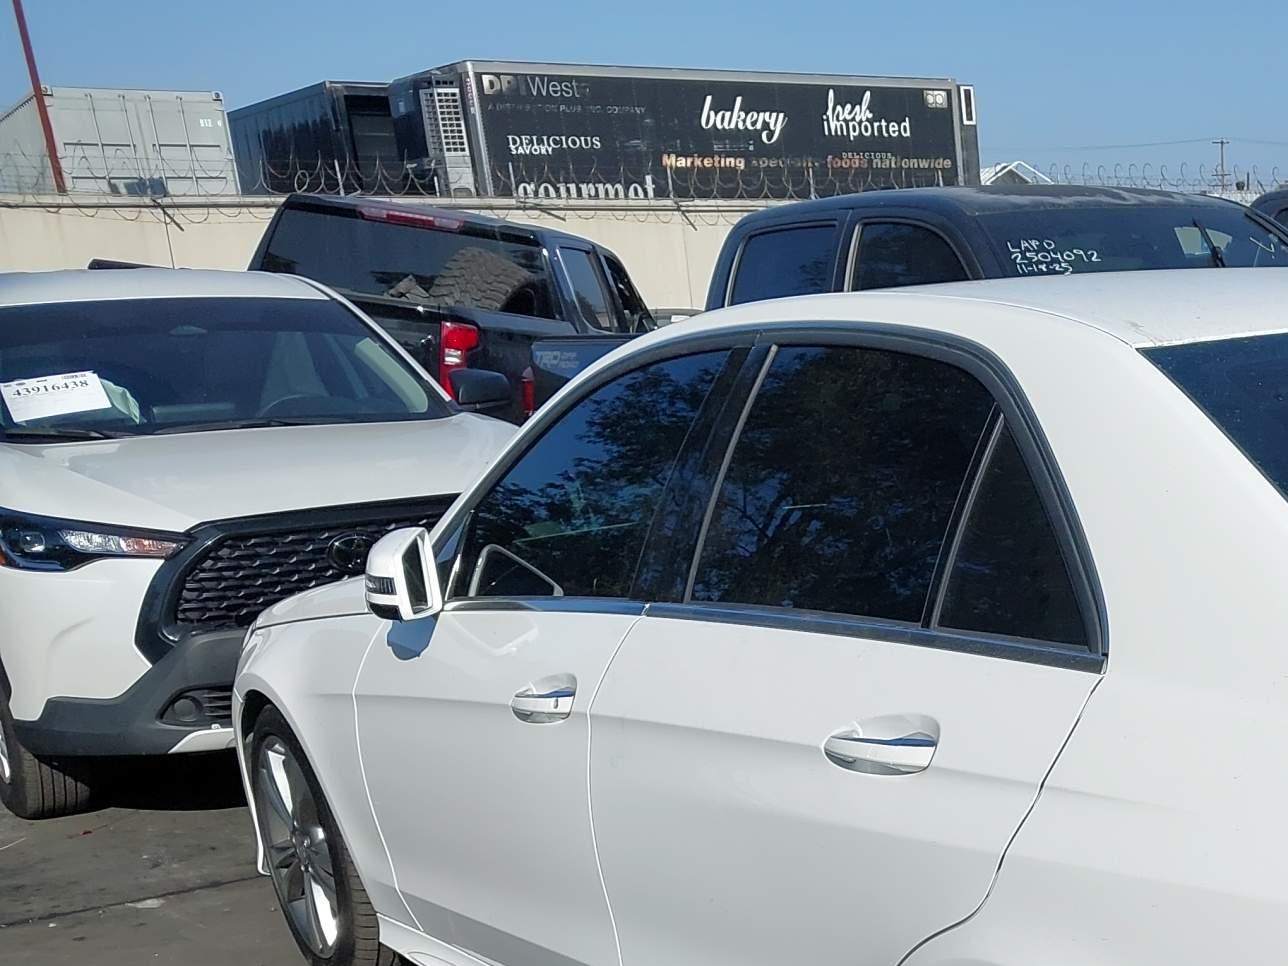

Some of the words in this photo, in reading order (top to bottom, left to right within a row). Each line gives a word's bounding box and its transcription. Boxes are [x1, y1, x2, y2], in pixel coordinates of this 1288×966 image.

[529, 76, 581, 97] West
[700, 95, 788, 144] bakery
[826, 88, 873, 136] fresh
[822, 114, 911, 140] imported
[506, 135, 601, 149] DELICIOUS
[510, 145, 553, 155] SAVORY
[662, 153, 746, 170] Marketing
[826, 154, 869, 169] foods
[872, 155, 952, 169] nationwide
[1007, 239, 1056, 252] LAPD
[1011, 249, 1102, 263] 2504092
[12, 380, 89, 396] 43916438
